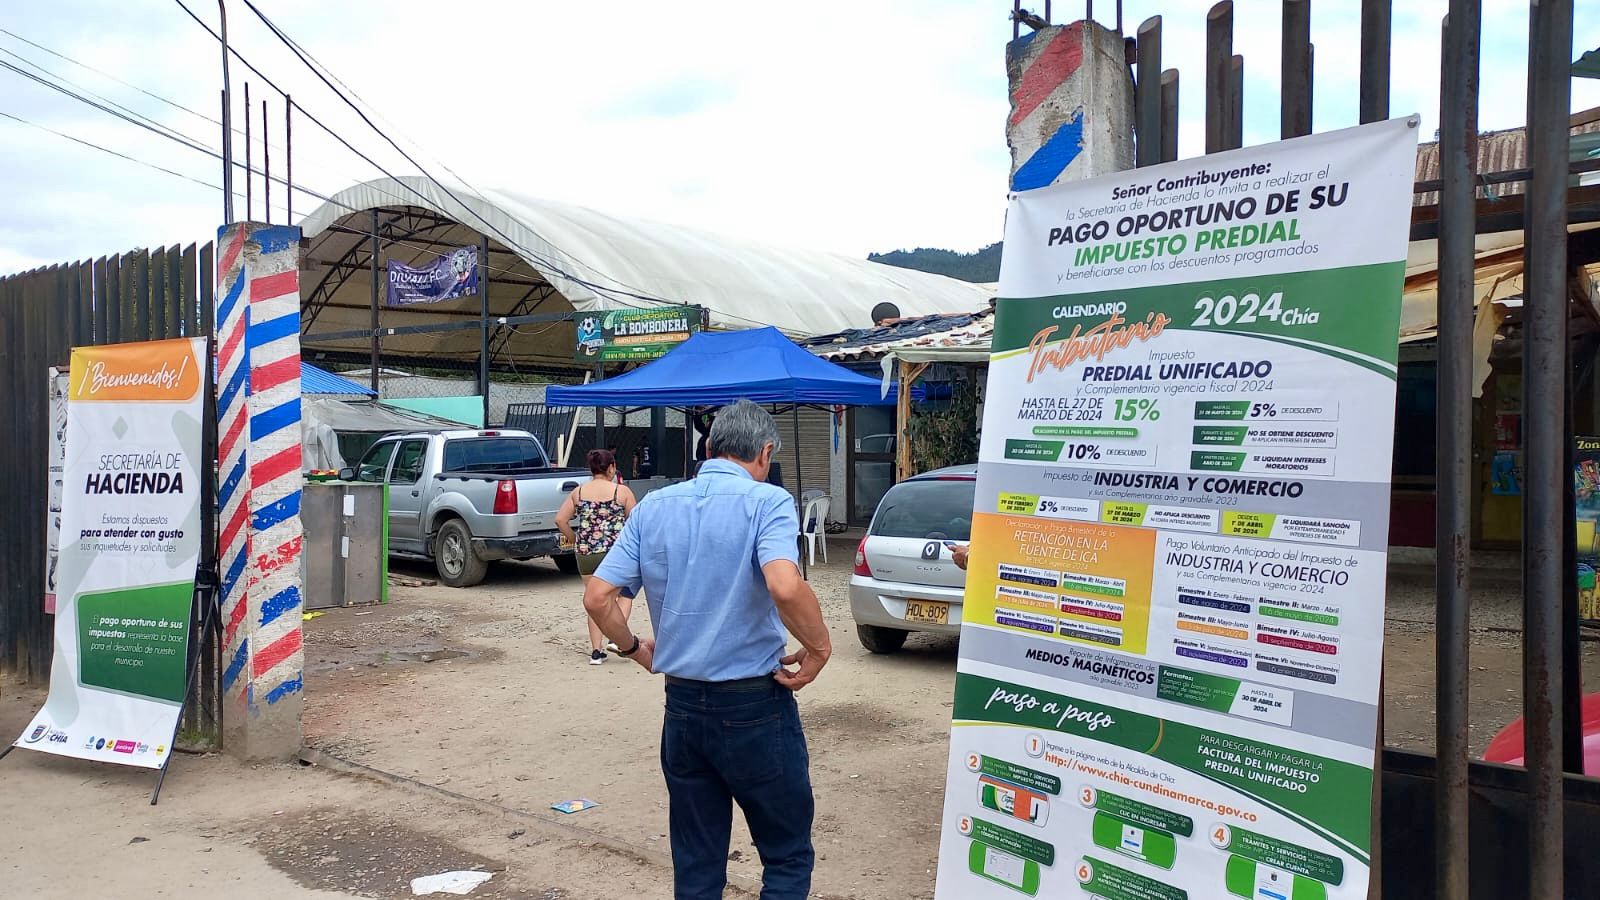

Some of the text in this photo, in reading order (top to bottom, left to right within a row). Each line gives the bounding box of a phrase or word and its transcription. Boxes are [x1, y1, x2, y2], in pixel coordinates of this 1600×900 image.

[1112, 163, 1271, 200] Señor Contribuyente:
[1066, 165, 1330, 220] la Secretaría de Hacienda lo invita a realizar el
[1048, 182, 1349, 246] PAGO OPORTUNO DE SU
[1074, 220, 1300, 266] IMPUESTO PREDIAL
[1057, 242, 1319, 283] y beneficiarse con los descuentos programados
[1052, 302, 1127, 319] CALENDARIO
[1191, 292, 1319, 326] 2024 Chía
[615, 319, 688, 335] LA BOMBONERA
[1027, 312, 1171, 383] Tributario
[1149, 350, 1195, 362] Impuesto
[77, 356, 189, 395] ¡Bienvenidos!
[1083, 361, 1272, 381] PREDIAL UNIFICADO
[1076, 380, 1273, 396] y Complementario vigencia fiscal 2024
[1022, 398, 1104, 408] HASTA EL 27 DE
[1114, 399, 1160, 421] 15%
[1251, 404, 1276, 417] 5%
[1018, 410, 1102, 420] MARZO DE 2024
[99, 450, 181, 470] SECRETARÍA DE
[1068, 444, 1100, 459] 10%
[85, 472, 183, 494] HACIENDA
[1043, 470, 1303, 498] Impuesto de INDUSTRIA Y COMERCIO
[1039, 501, 1058, 512] 5%
[102, 513, 168, 527] Estamos dispuestos
[80, 526, 183, 541] para atender con gusto
[1014, 530, 1108, 551] RETENCIÓN EN LA
[80, 541, 176, 554] sus inquietudes y solicitudes
[1020, 544, 1097, 563] FUENTE DE ICA
[1167, 538, 1358, 567] Pago Voluntario Anticipado del Impuesto de
[1167, 552, 1349, 586] INDUSTRIA Y COMERCIO
[100, 617, 119, 626] pago
[122, 618, 156, 629] oportuno
[158, 618, 168, 627] de
[171, 621, 183, 629] sus
[89, 627, 126, 638] impuestos
[168, 632, 183, 642] base
[91, 641, 175, 655] para el desarrollo de nuestro
[1026, 649, 1155, 684] MEDIOS MAGNÉTICOS
[1164, 670, 1194, 681] Formatos:
[985, 687, 1116, 731] paso a paso
[1258, 698, 1273, 706] ABRIL
[1032, 739, 1037, 751] 1
[1200, 734, 1322, 770] PARA DESCARGAR Y PAGAR LA
[969, 755, 977, 767] 2
[1198, 746, 1320, 784] FACTURA DEL IMPUESTO
[1205, 760, 1307, 793] PREDIAL UNIFICADO
[1045, 752, 1257, 822] http://www.chia-cundinamarca.gov.co
[1083, 790, 1091, 802] 3
[961, 819, 969, 830] 5
[1140, 815, 1166, 828] INGRESAR
[1214, 828, 1225, 842] 4
[1276, 848, 1307, 861] SERVICIOS
[1079, 867, 1088, 879] 6
[1266, 857, 1309, 875] CREAR CUENTA
